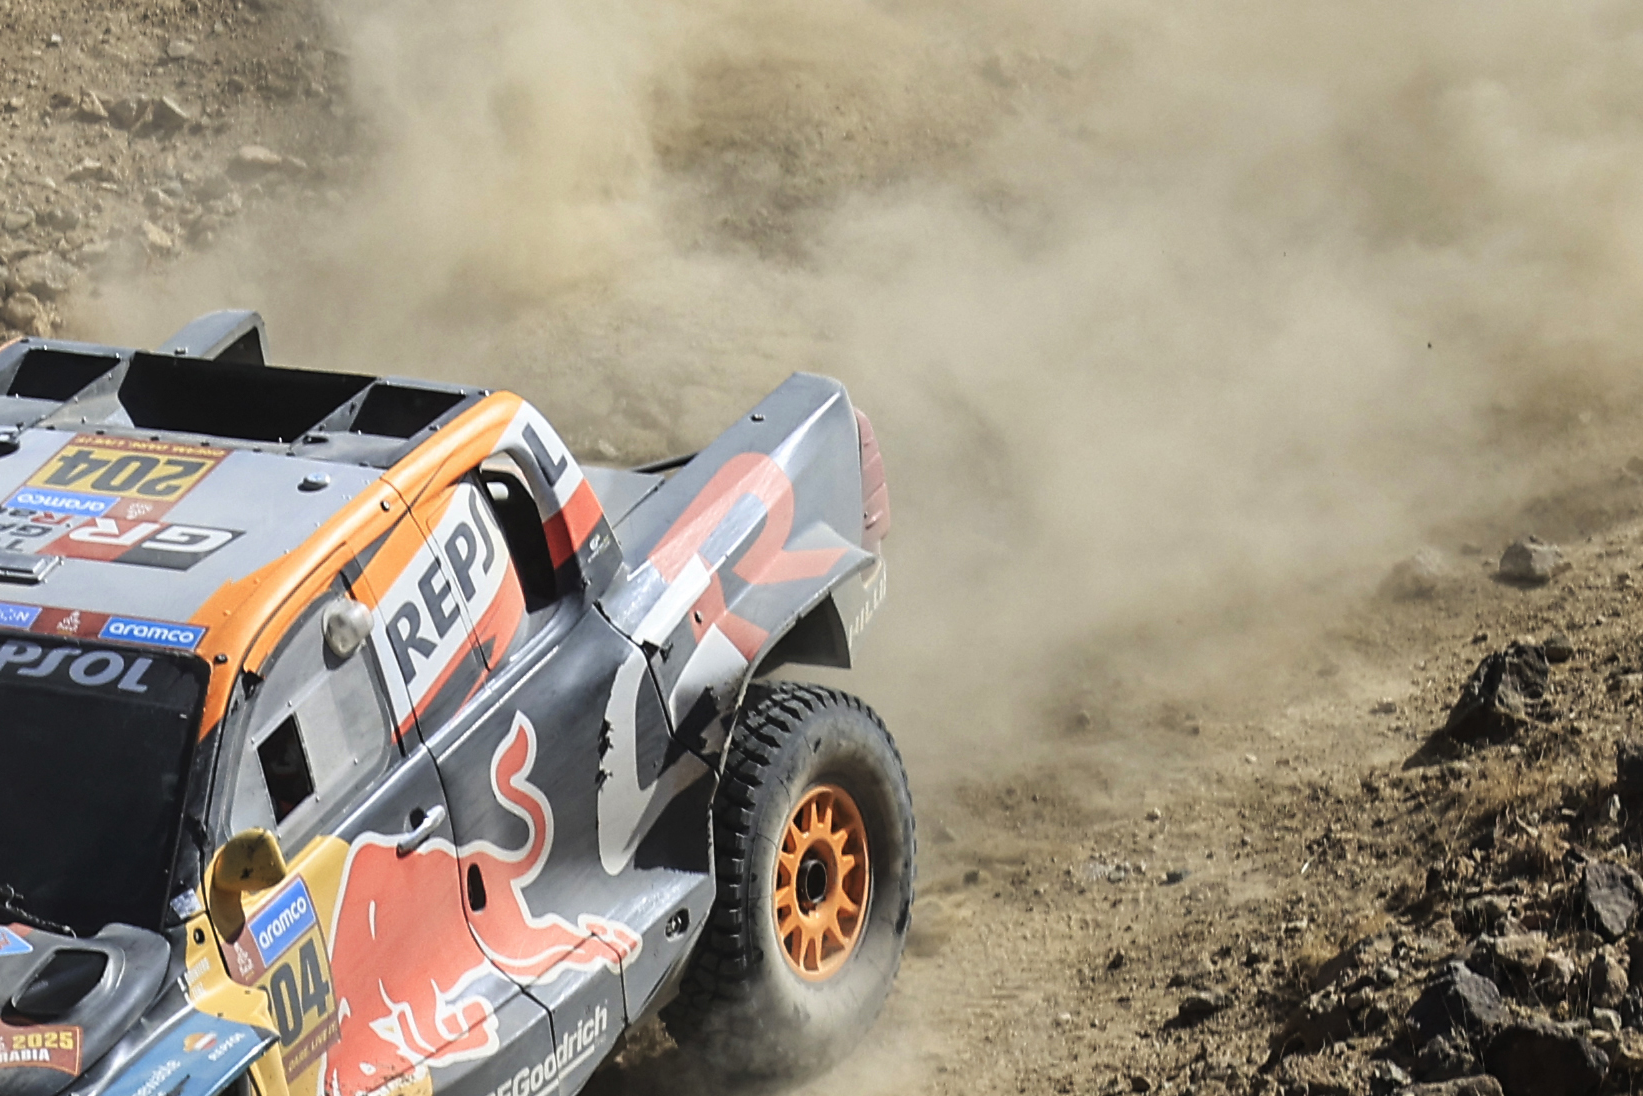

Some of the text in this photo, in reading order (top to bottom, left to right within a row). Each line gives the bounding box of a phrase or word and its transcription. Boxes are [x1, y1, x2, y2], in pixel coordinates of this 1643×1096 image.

[46, 449, 206, 496] 204
[17, 494, 105, 512] aramco
[69, 517, 233, 552] GR
[109, 621, 195, 643] aramco
[258, 896, 307, 950] aramco
[12, 1031, 74, 1050] 2025
